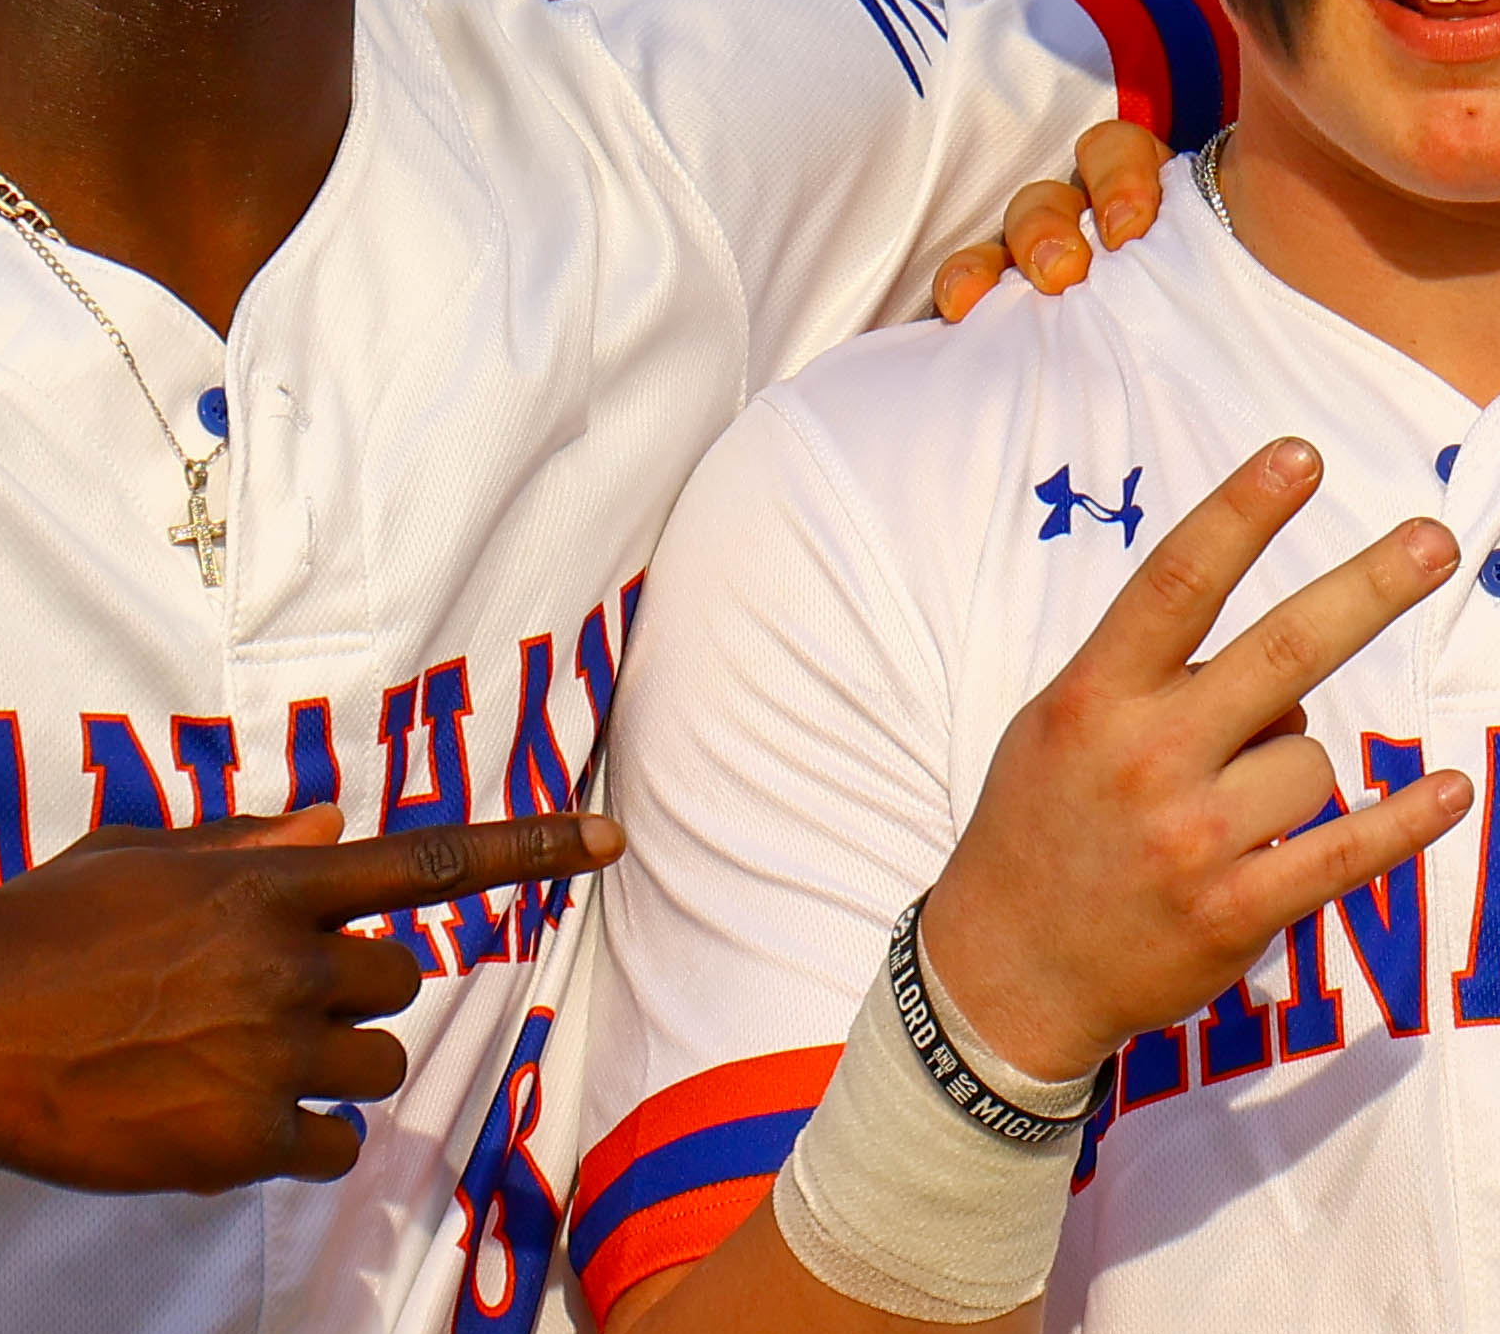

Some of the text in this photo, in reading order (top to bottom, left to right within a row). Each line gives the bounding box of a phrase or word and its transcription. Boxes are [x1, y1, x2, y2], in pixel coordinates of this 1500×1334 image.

[893, 966, 938, 1049] LORD
[932, 1043, 958, 1073] AND
[946, 1073, 978, 1105] HIS
